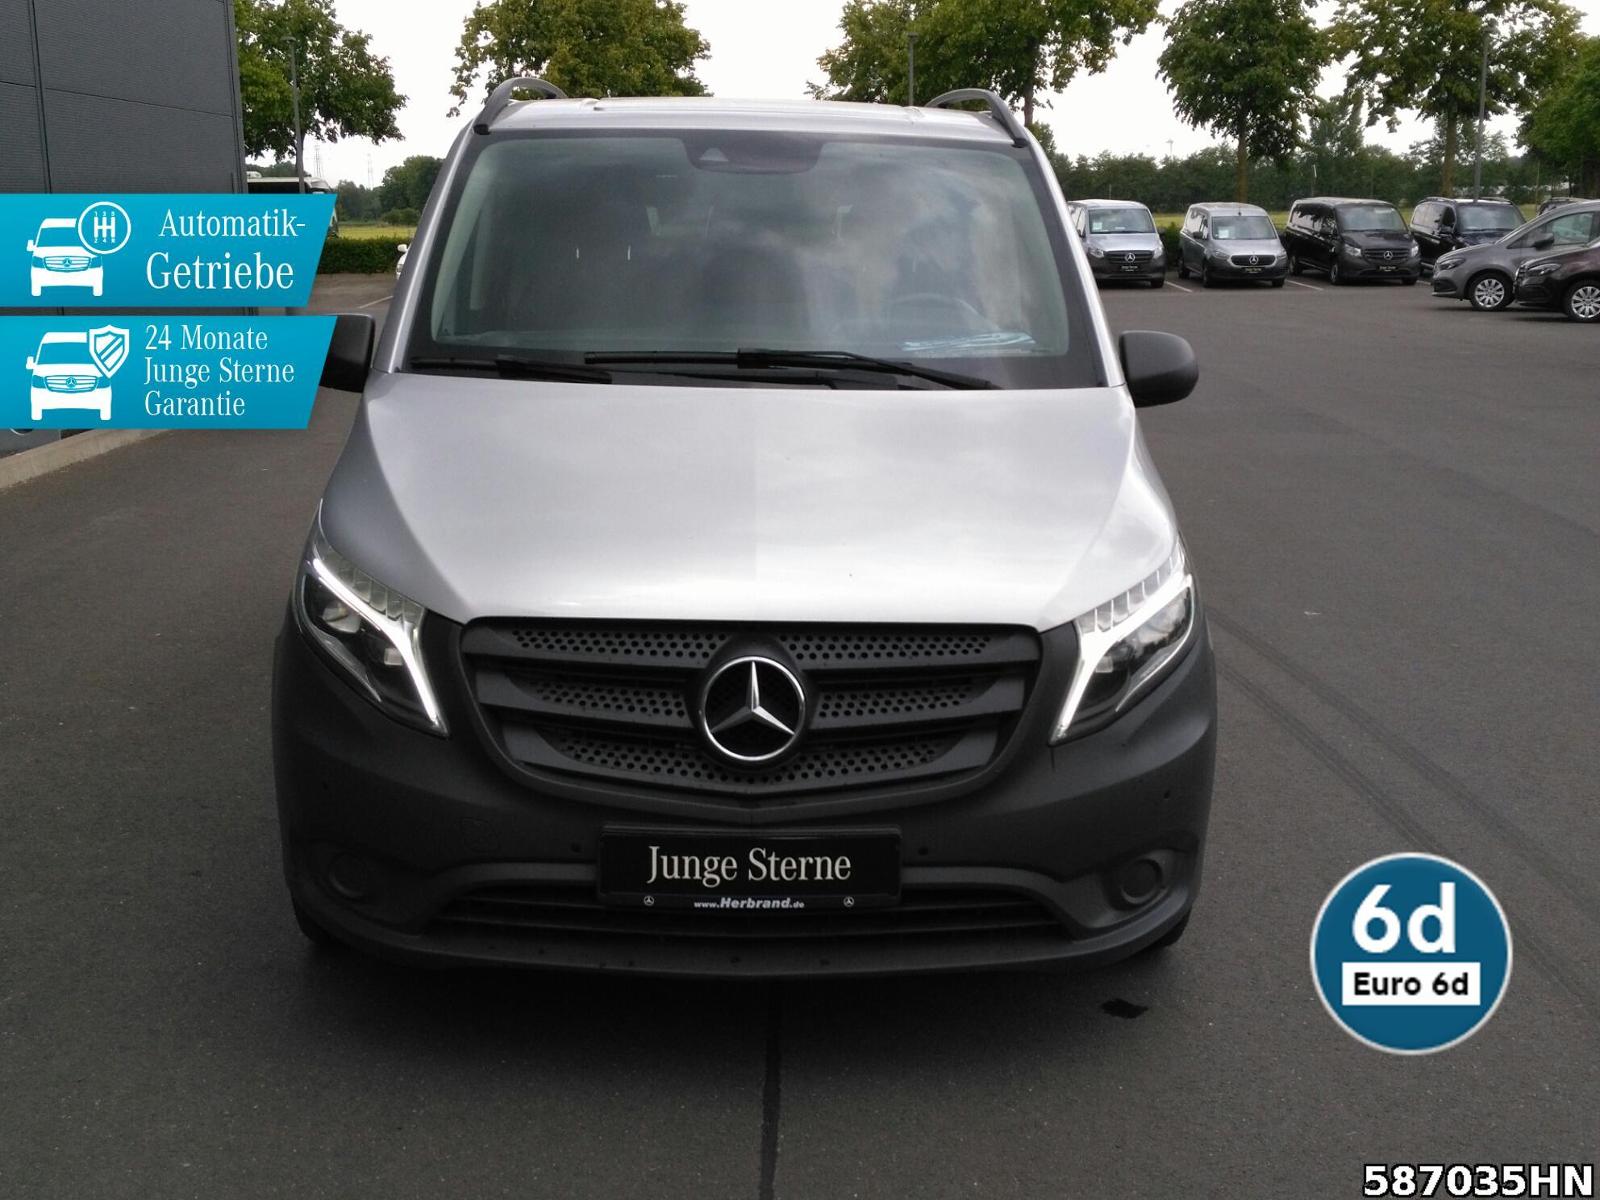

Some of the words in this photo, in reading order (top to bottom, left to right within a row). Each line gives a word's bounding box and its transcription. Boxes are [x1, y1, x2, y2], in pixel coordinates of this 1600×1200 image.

[646, 845, 738, 888] Junge
[748, 847, 851, 881] Sterne
[693, 897, 805, 909] www.Herbrand.de
